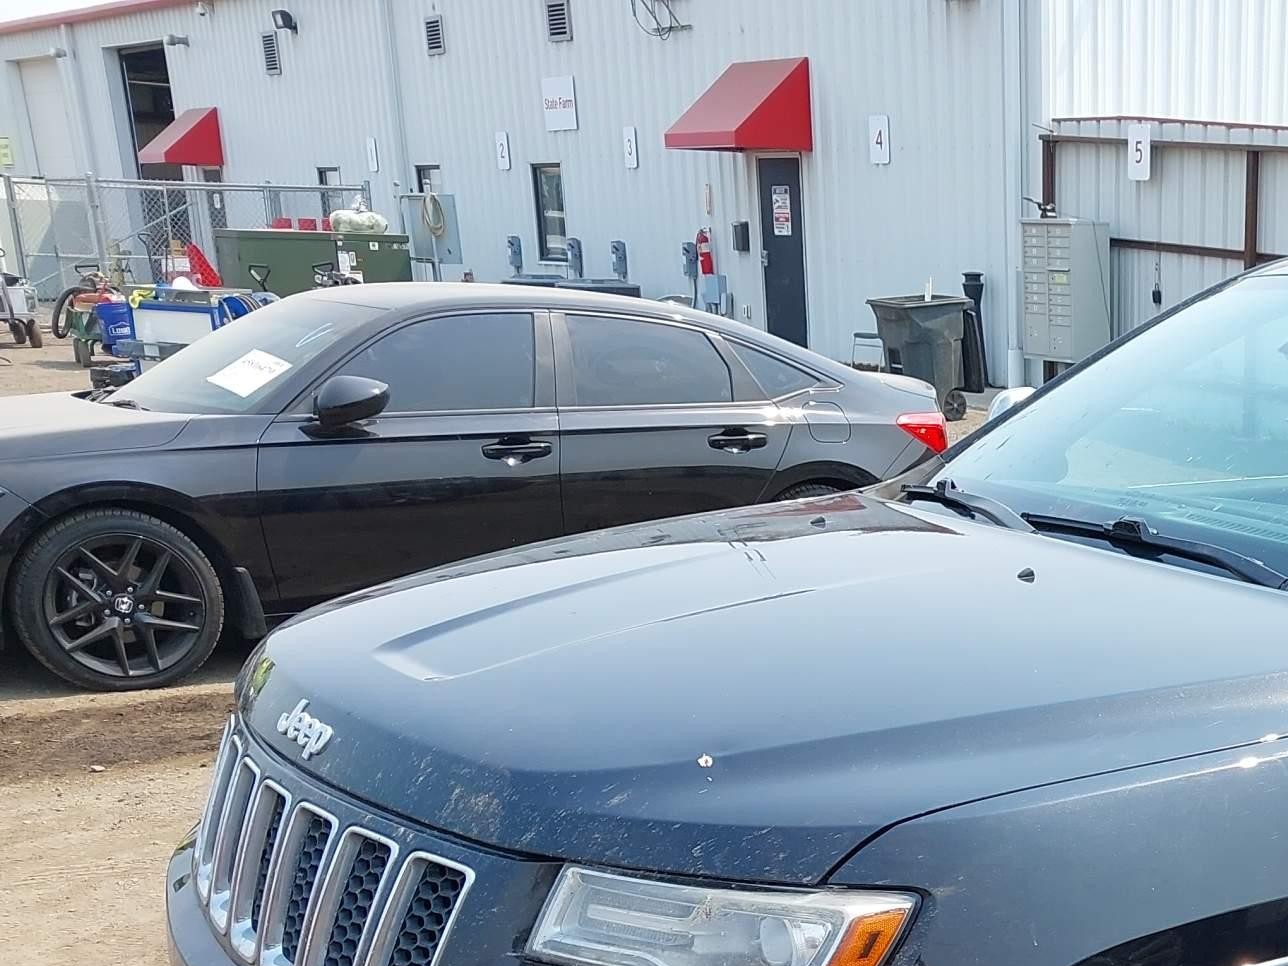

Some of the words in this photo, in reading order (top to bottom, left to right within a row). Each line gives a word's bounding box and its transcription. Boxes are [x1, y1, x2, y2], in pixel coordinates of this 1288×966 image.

[544, 97, 558, 110] State
[558, 96, 574, 109] Farm
[627, 138, 633, 156] 3
[874, 129, 883, 151] 4
[499, 142, 505, 159] 2
[1135, 140, 1143, 164] 5
[276, 698, 333, 761] Jeep
